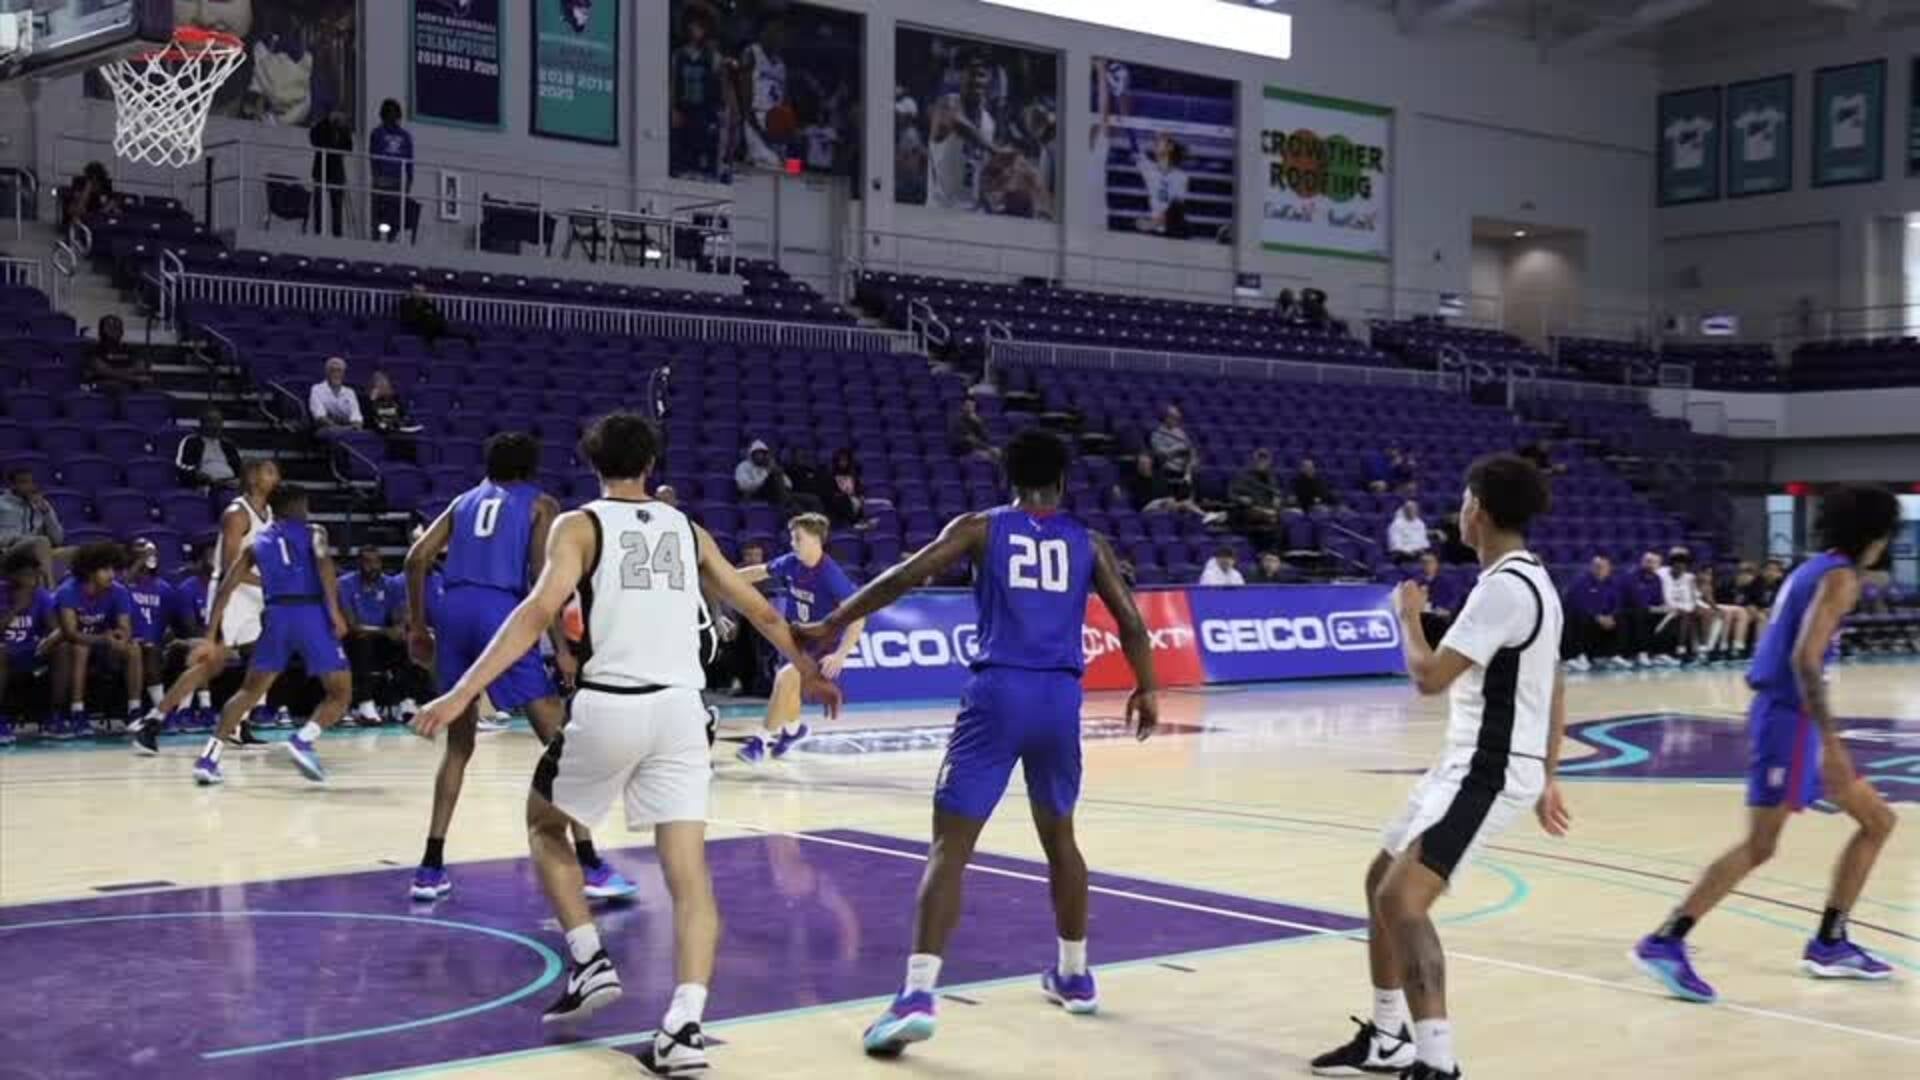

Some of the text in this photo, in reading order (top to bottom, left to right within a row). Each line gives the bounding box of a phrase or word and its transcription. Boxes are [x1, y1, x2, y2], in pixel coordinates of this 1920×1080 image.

[1261, 129, 1384, 173] CROWTHER
[1270, 162, 1372, 200] ROOFING
[474, 499, 501, 537] 0
[276, 536, 291, 566] 1
[619, 531, 685, 591] 24
[1008, 534, 1070, 592] 20
[842, 629, 952, 669] EICO
[1202, 617, 1328, 654] GEICO
